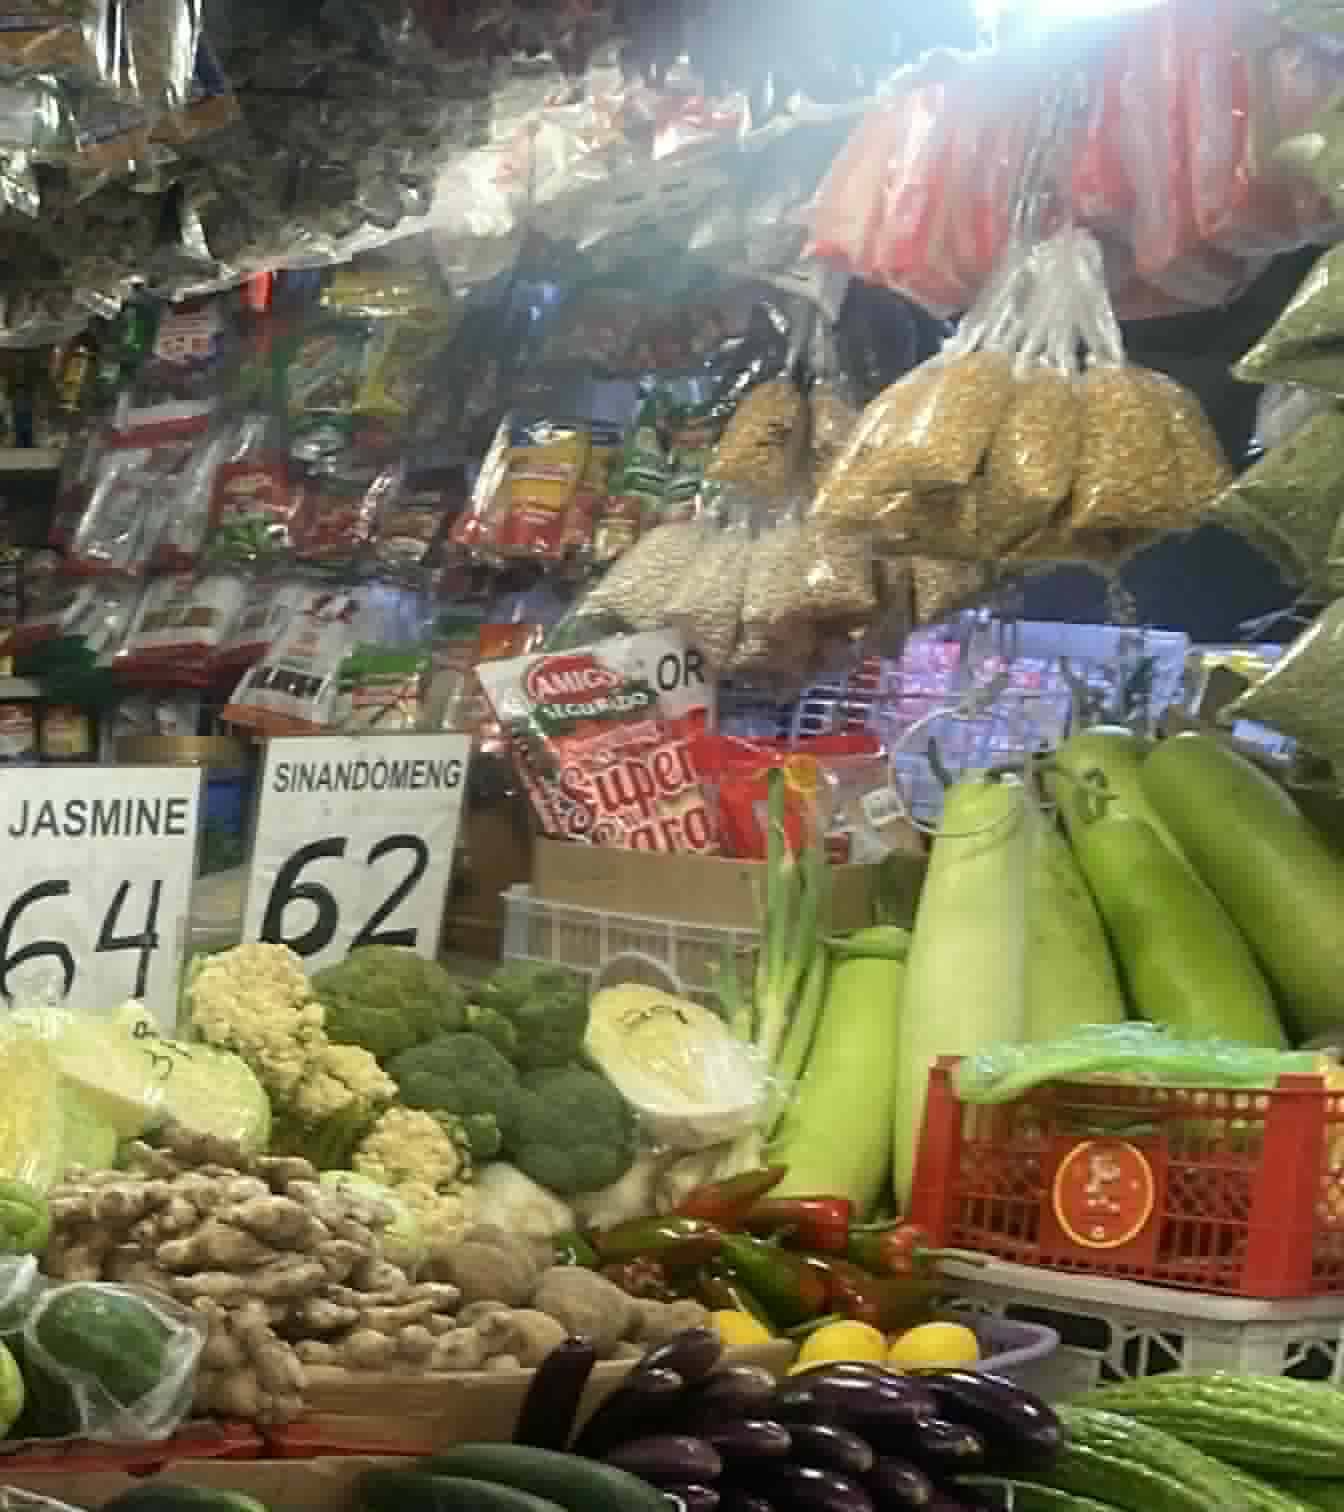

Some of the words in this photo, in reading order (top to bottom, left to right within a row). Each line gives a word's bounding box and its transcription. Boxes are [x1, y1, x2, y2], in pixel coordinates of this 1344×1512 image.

[656, 645, 707, 694] OR
[272, 758, 462, 793] SINANDOMENG
[7, 798, 190, 838] JASMINE
[260, 833, 431, 958] 62
